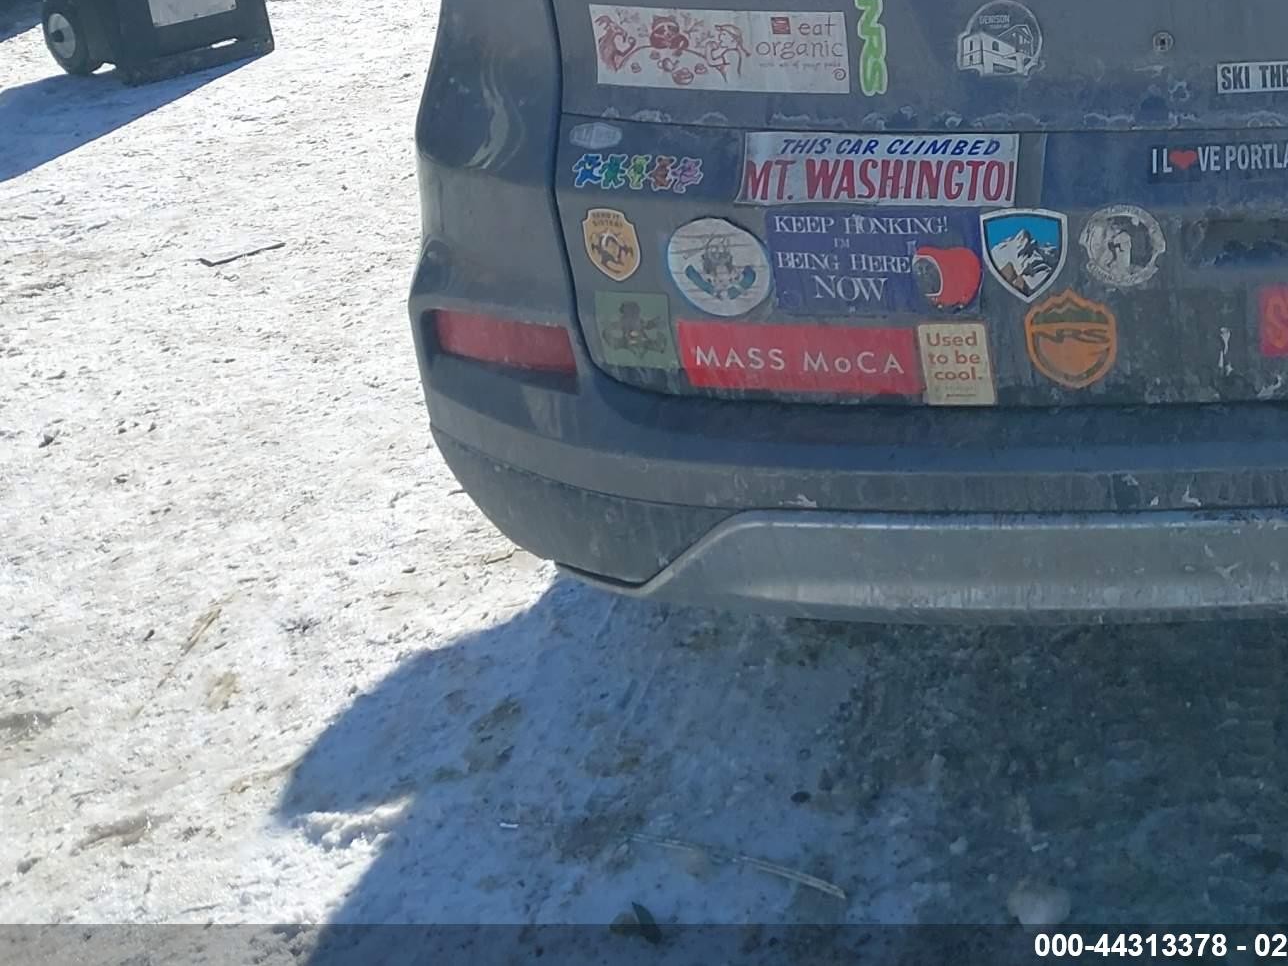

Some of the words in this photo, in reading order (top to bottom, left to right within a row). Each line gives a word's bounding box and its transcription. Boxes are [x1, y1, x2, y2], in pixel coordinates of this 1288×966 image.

[797, 14, 837, 36] eat
[755, 40, 844, 60] organic
[1220, 64, 1251, 91] SKI
[779, 138, 829, 156] THIS
[834, 139, 878, 156] CAR
[886, 138, 1001, 157] CLIMBED
[744, 159, 796, 203] MT.
[805, 158, 1015, 202] WASHINGTO
[773, 215, 835, 234] KEEP
[843, 214, 948, 234] HONKING!
[776, 250, 840, 272] BEING
[850, 253, 914, 274] HERE
[813, 275, 889, 302] NOW
[926, 331, 978, 349] Used
[1032, 327, 1109, 345] NRS
[694, 344, 786, 372] MASS
[803, 350, 905, 376] MoCA
[928, 351, 950, 366] to
[954, 348, 981, 366] be
[934, 366, 984, 382] cool.
